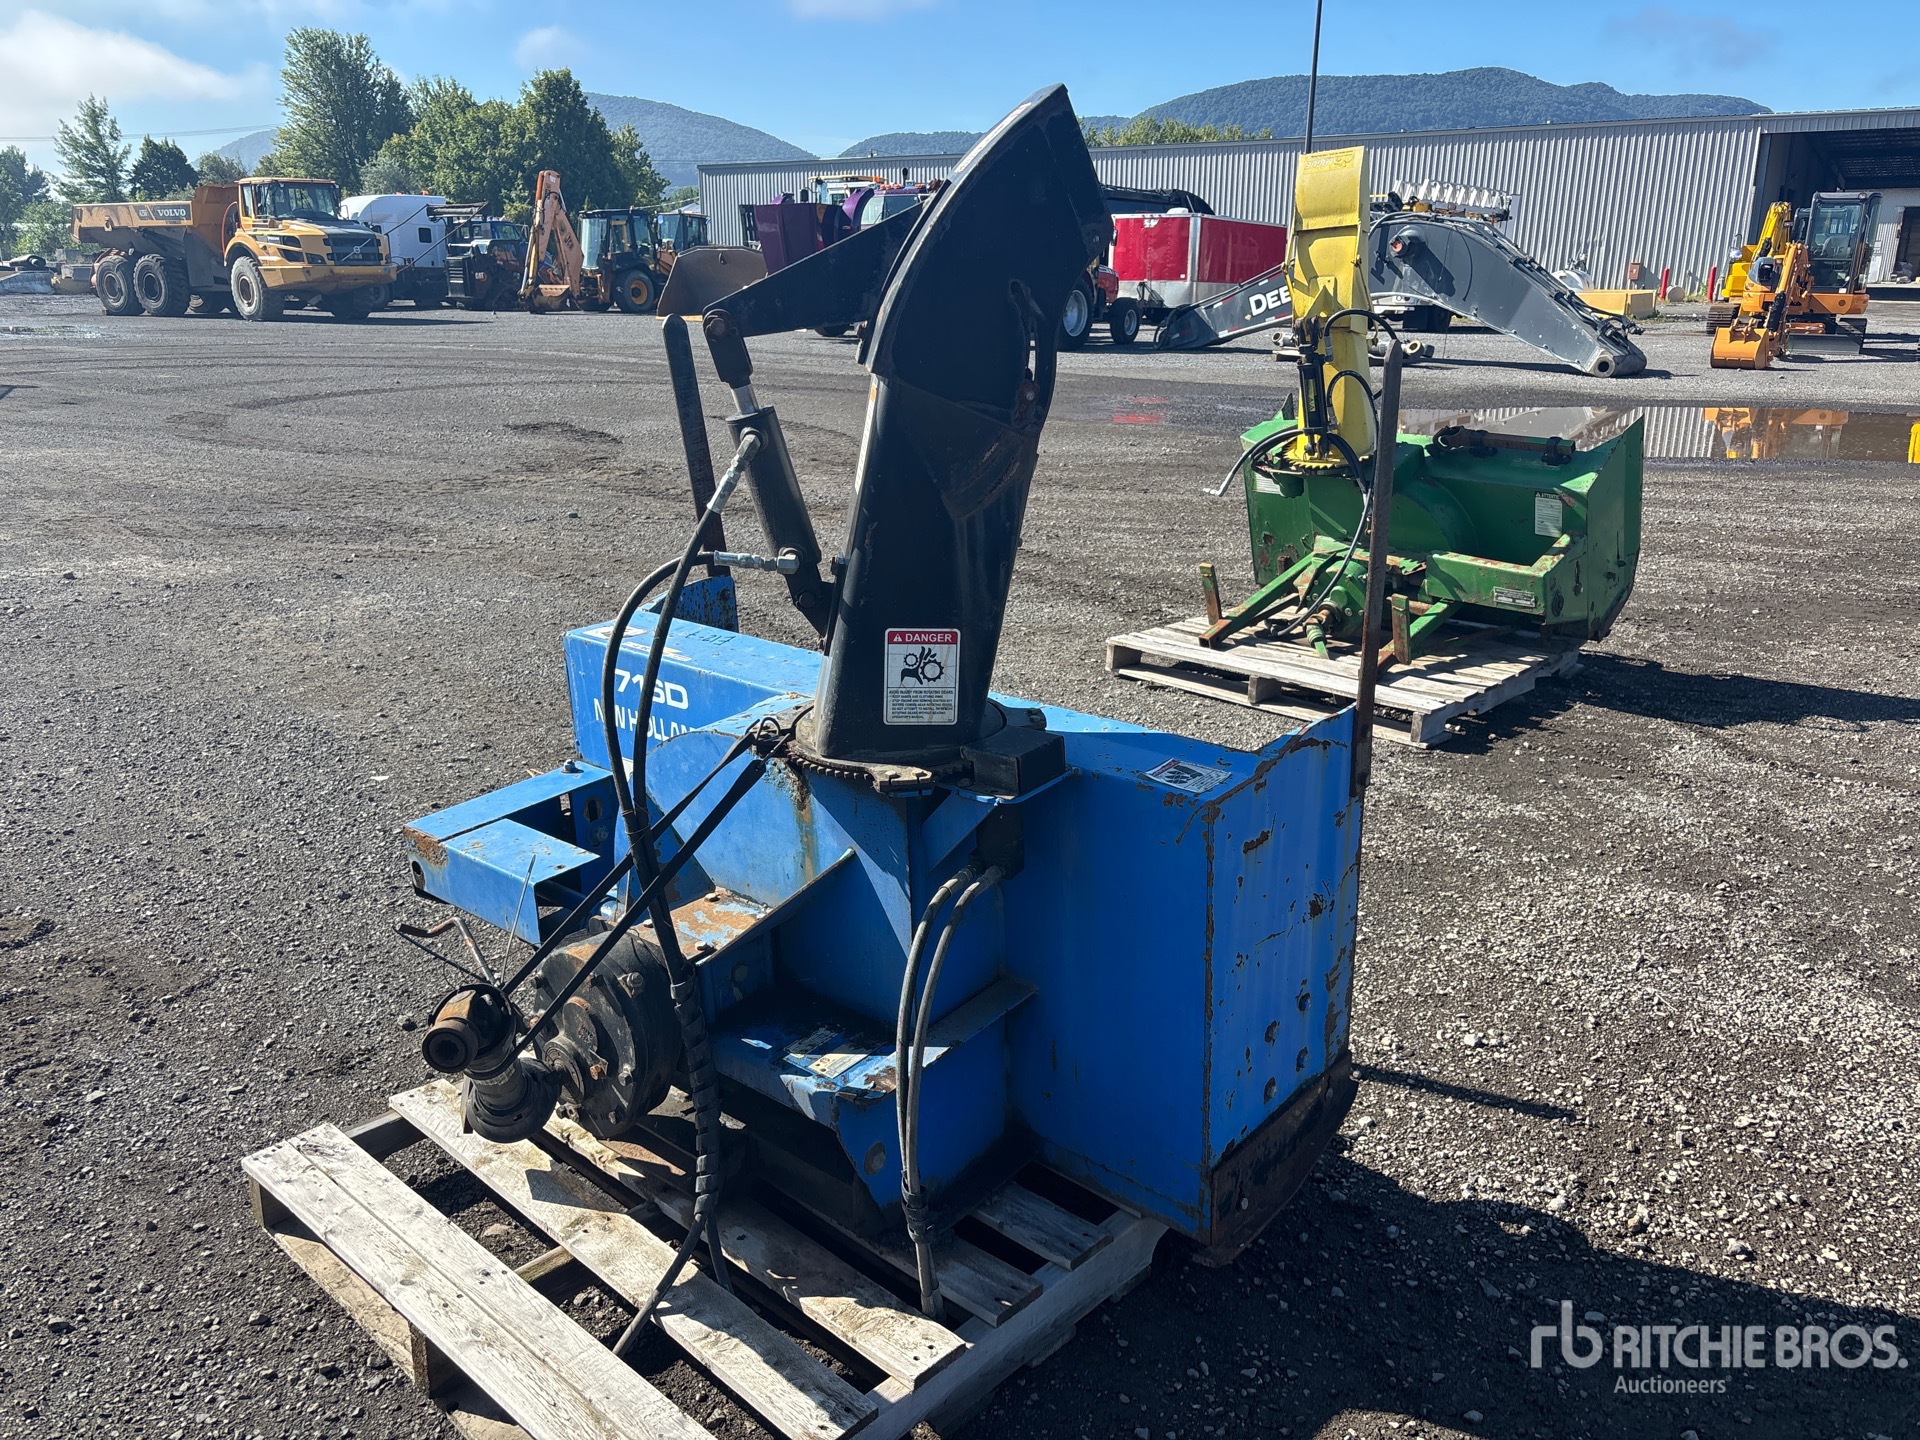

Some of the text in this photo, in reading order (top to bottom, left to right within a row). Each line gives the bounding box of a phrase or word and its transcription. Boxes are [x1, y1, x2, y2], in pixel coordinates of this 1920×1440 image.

[157, 209, 186, 217] VOLVO
[1249, 285, 1292, 316] DEE
[905, 633, 952, 642] DANGER
